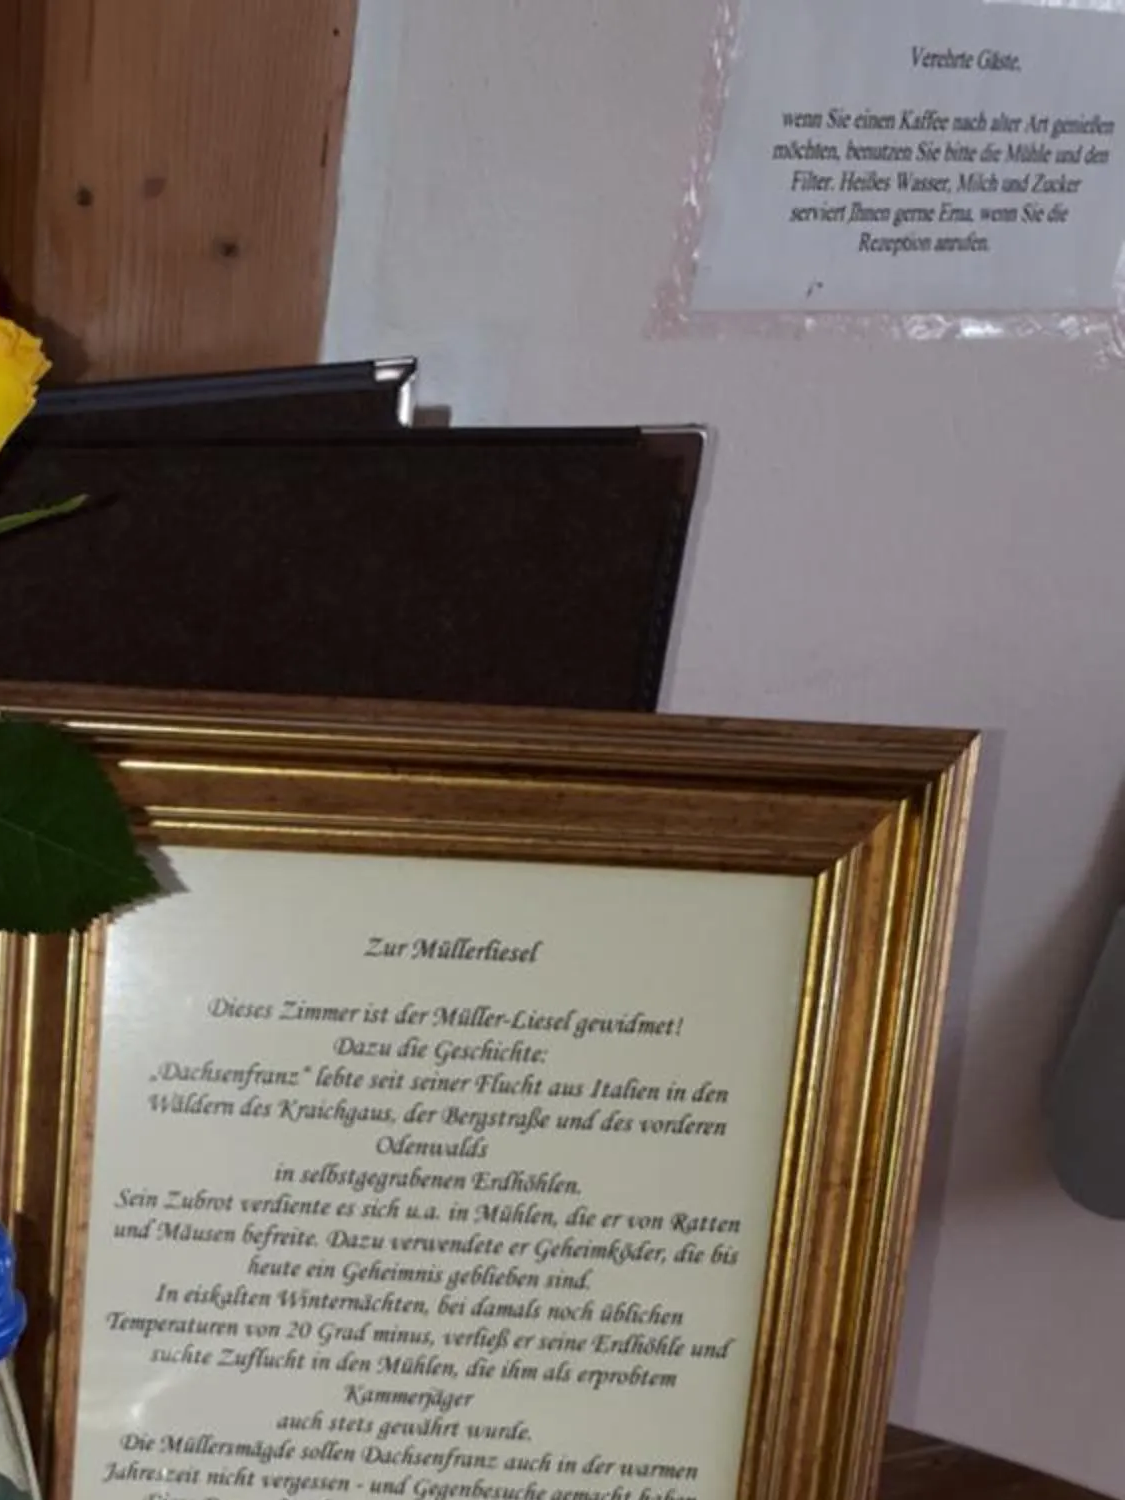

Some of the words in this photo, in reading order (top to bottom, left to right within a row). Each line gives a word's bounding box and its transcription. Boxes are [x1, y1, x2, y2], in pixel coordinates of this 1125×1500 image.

[364, 937, 407, 958] Zur
[411, 938, 544, 963] Müllerliesel
[207, 997, 273, 1018] Dieses
[279, 1000, 360, 1022] Zimmer
[363, 1002, 389, 1023] ist
[395, 1002, 429, 1025] der
[432, 1006, 578, 1032] Müller-Liesel
[573, 1012, 685, 1038] gewidmet!
[333, 1036, 392, 1057] Dazu
[397, 1037, 428, 1058] die
[434, 1040, 548, 1066] Geschichte:
[315, 1066, 363, 1088] lebte
[367, 1070, 404, 1090] seit
[410, 1071, 471, 1092] seiner
[474, 1073, 544, 1097] Flucht
[547, 1081, 584, 1098] aus
[589, 1077, 660, 1101] Italien
[666, 1082, 687, 1102] in
[691, 1081, 729, 1104] den
[148, 1092, 234, 1116] Wäldern
[239, 1096, 271, 1117] des
[278, 1099, 396, 1127] Kraichgaus,
[403, 1103, 437, 1124] der
[441, 1106, 550, 1134] Bergstraße
[555, 1109, 601, 1130] und
[599, 1110, 633, 1132] des
[638, 1113, 727, 1136] vorderen
[376, 1135, 488, 1159] Odenwalds
[273, 1163, 295, 1183] in
[299, 1162, 466, 1193] selbstgegrabenen
[471, 1169, 582, 1196] Erdhöhlen.
[114, 1188, 159, 1209] Sein
[164, 1189, 234, 1212] Zubrot
[240, 1192, 332, 1217] verdiente
[335, 1202, 355, 1217] es
[361, 1197, 400, 1220] sich
[448, 1202, 469, 1222] in
[473, 1202, 558, 1228] Mühlen,
[564, 1206, 597, 1227] die
[600, 1213, 623, 1228] er
[627, 1214, 664, 1230] von
[669, 1212, 741, 1235] Ratten
[113, 1220, 157, 1239] und
[156, 1221, 236, 1243] Mäusen
[242, 1223, 319, 1251] befreite.
[326, 1229, 385, 1249] Dazu
[390, 1232, 504, 1256] verwendete
[508, 1240, 531, 1255] er
[533, 1237, 667, 1266] Geheimköder,
[673, 1244, 705, 1265] die
[710, 1245, 740, 1266] bis
[247, 1255, 302, 1277] heute
[306, 1261, 335, 1278] ein
[341, 1260, 443, 1286] Geheimnis
[445, 1266, 539, 1291] geblieben
[544, 1269, 592, 1291] sind.
[155, 1283, 179, 1303] In
[183, 1284, 272, 1310] eiskalten
[277, 1287, 430, 1315] Winternächten,
[437, 1295, 466, 1316] bei
[470, 1297, 540, 1320] damals
[546, 1301, 593, 1322] noch
[600, 1301, 684, 1325] üblichen
[106, 1311, 238, 1338] Temperaturen
[244, 1321, 280, 1337] von
[286, 1322, 311, 1339] 20
[317, 1322, 373, 1346] Grad
[372, 1327, 435, 1347] minus,
[442, 1329, 511, 1353] verließ
[513, 1335, 532, 1350] er
[538, 1334, 587, 1352] seine
[590, 1335, 686, 1357] Erdhöhle
[689, 1337, 737, 1360] und
[344, 1384, 474, 1413] Kammerjäger
[276, 1410, 323, 1430] auch
[327, 1415, 374, 1433] stets
[376, 1419, 460, 1440] gewährt
[466, 1420, 532, 1441] wurde.
[120, 1434, 154, 1452] Die
[160, 1434, 296, 1464] Müllersmägde
[300, 1441, 356, 1462] sollen
[361, 1443, 497, 1473] Dachsenfranz
[503, 1453, 553, 1472] auch
[557, 1453, 577, 1474] in
[581, 1455, 616, 1476] der
[620, 1464, 699, 1480] warmen
